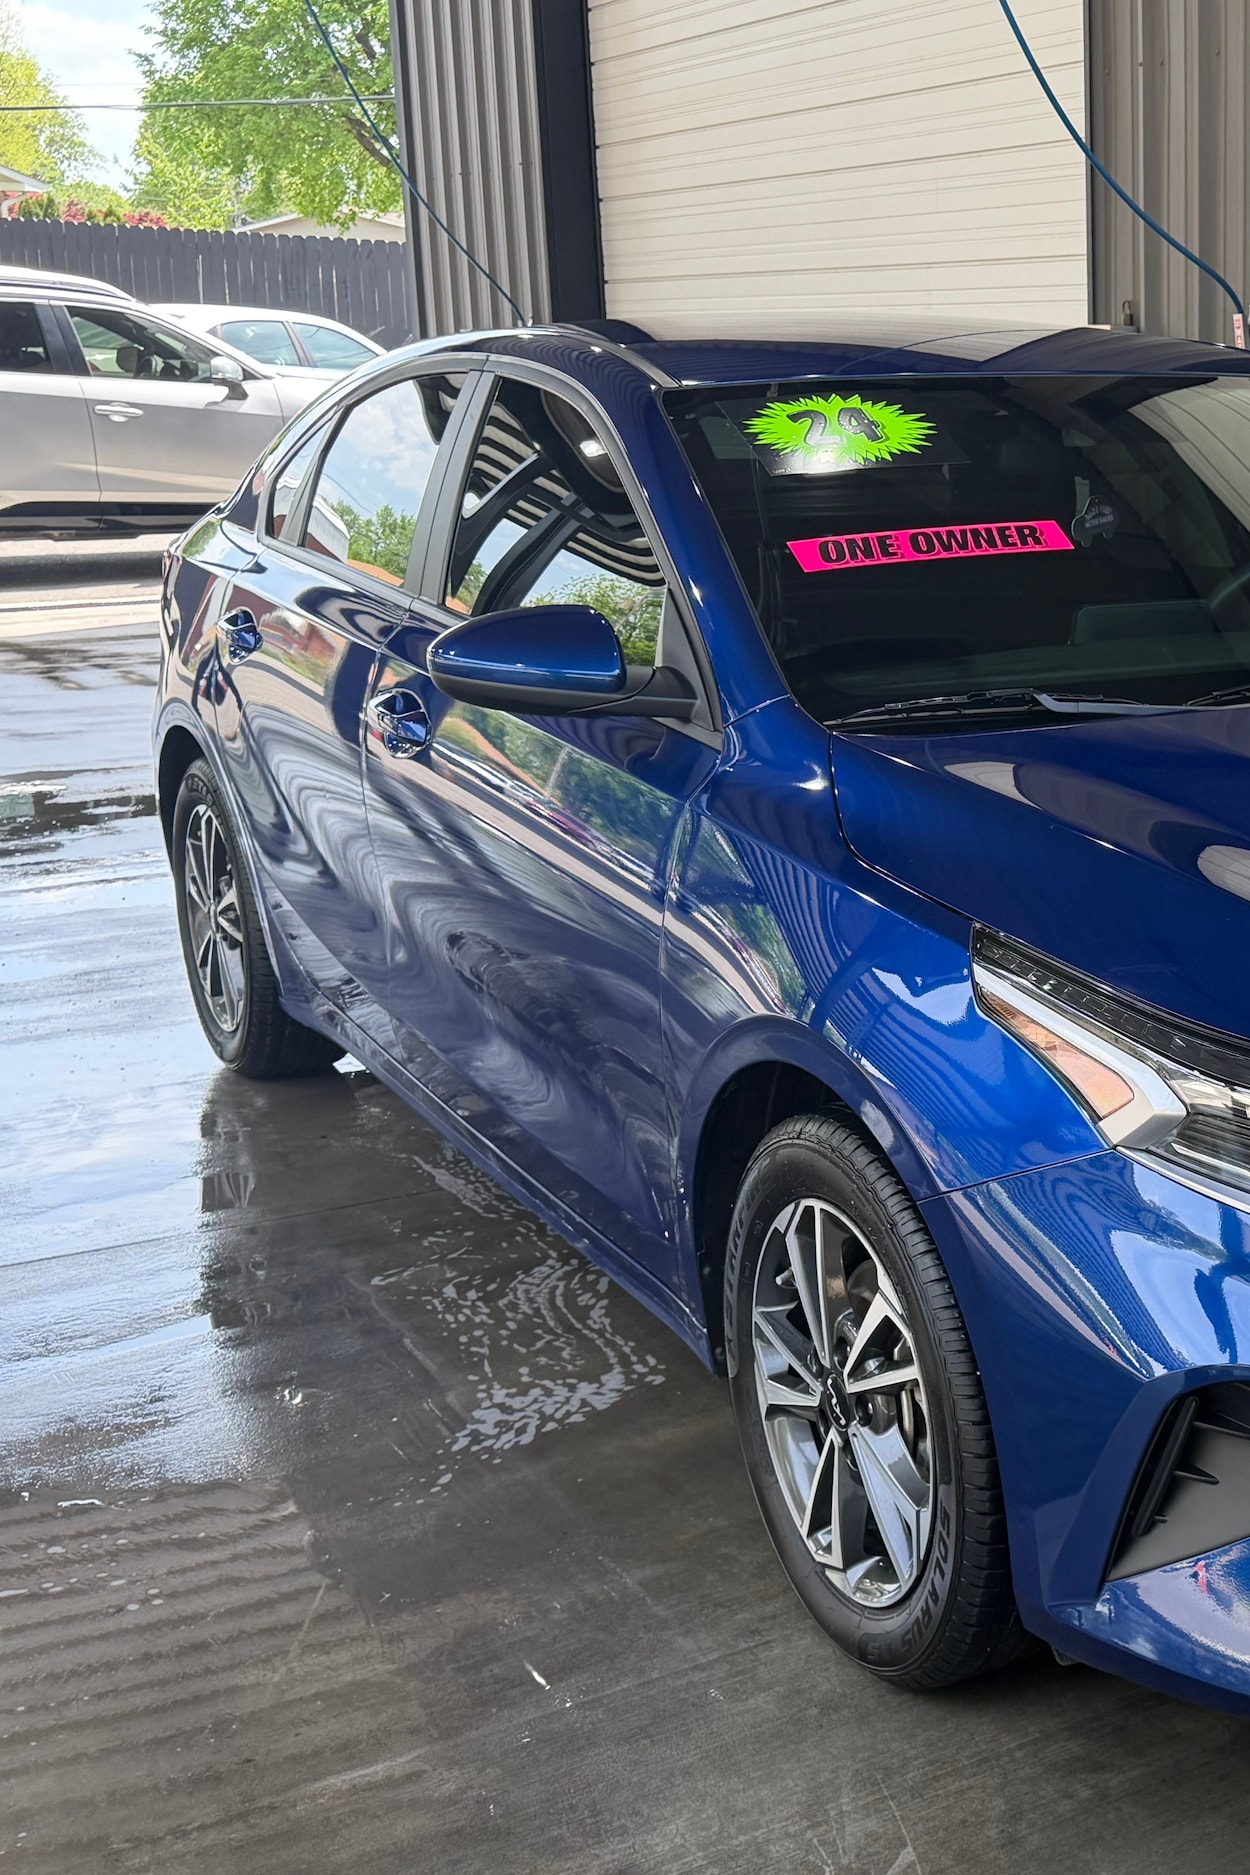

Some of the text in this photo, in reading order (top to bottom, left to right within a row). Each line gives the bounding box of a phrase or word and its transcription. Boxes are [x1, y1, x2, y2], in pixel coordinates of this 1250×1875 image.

[786, 407, 886, 446] 24
[818, 524, 1046, 565] ONE OWNER
